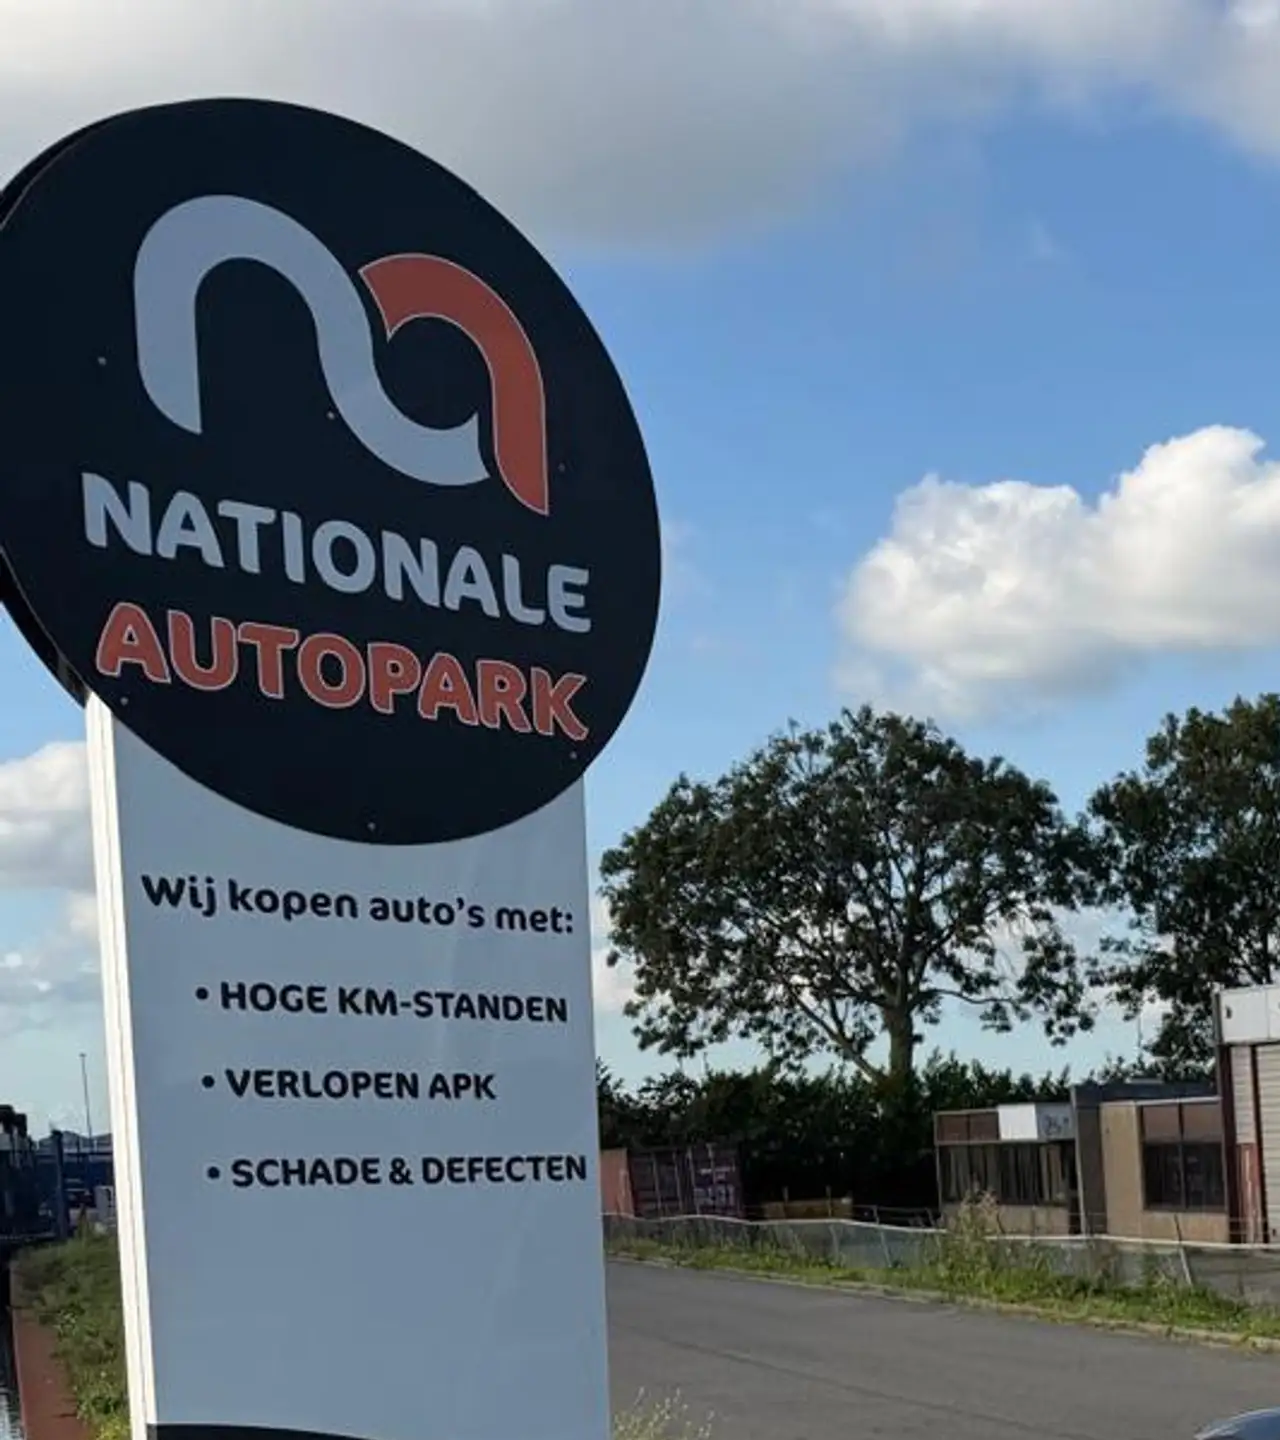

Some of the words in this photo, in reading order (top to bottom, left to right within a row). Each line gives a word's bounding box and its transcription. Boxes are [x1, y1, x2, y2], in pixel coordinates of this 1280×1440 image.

[82, 472, 592, 633] NATIONALE
[96, 602, 590, 741] AUTOPARK
[141, 874, 217, 918] Wij
[228, 878, 359, 922] kopen
[369, 896, 486, 929] auto's
[495, 906, 574, 934] met:
[220, 981, 328, 1014] HOGE
[338, 986, 568, 1023] KM-STANDEN
[225, 1068, 419, 1099] VERLOPEN
[428, 1073, 497, 1100] APK
[231, 1157, 382, 1188] SCHADE
[388, 1157, 414, 1186] &
[421, 1155, 587, 1185] DEFECTEN
